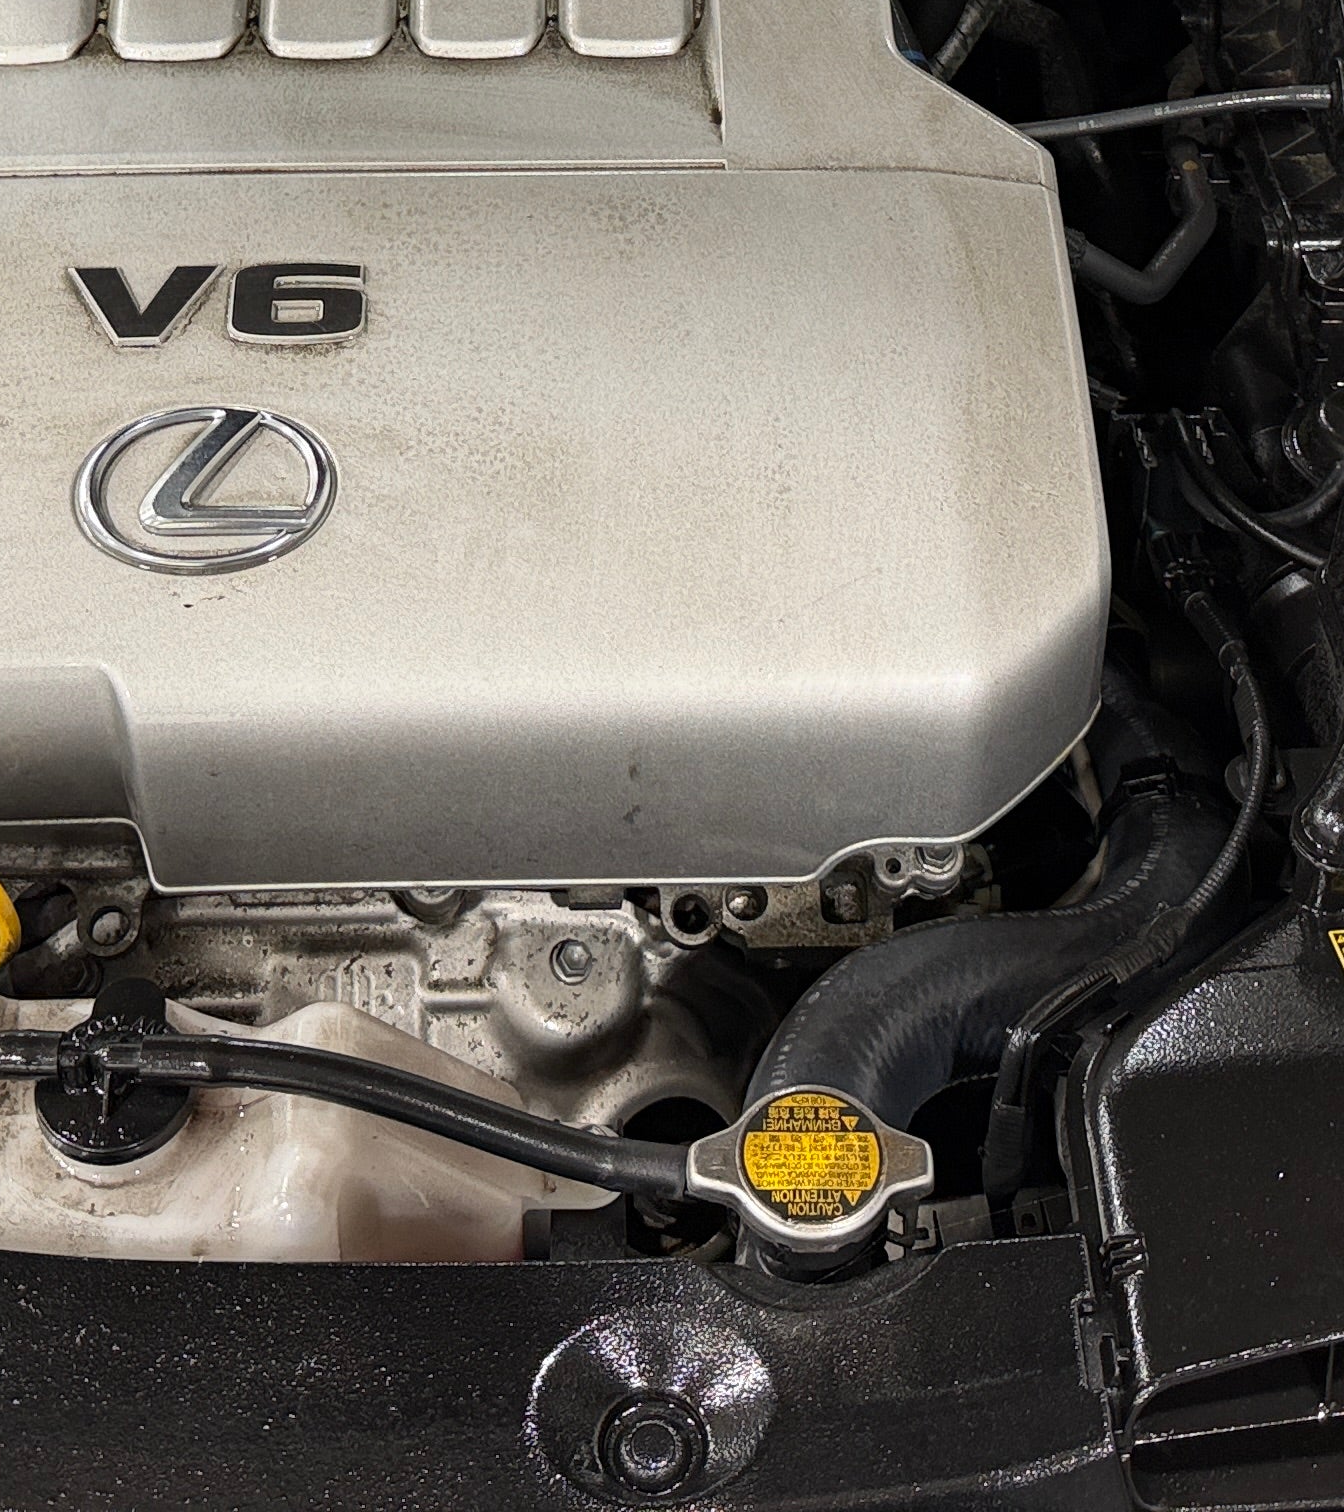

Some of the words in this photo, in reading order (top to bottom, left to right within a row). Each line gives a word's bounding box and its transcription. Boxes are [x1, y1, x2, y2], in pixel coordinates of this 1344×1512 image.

[67, 262, 370, 347] V6
[762, 1118, 842, 1131] ВНИМАНИЕ!
[756, 1179, 775, 1188] HOT
[778, 1179, 806, 1188] WHEN
[808, 1179, 834, 1188] OPEN
[836, 1179, 868, 1188] NEVER
[771, 1190, 842, 1203] ATTENTION
[788, 1202, 843, 1216] CAUTION
